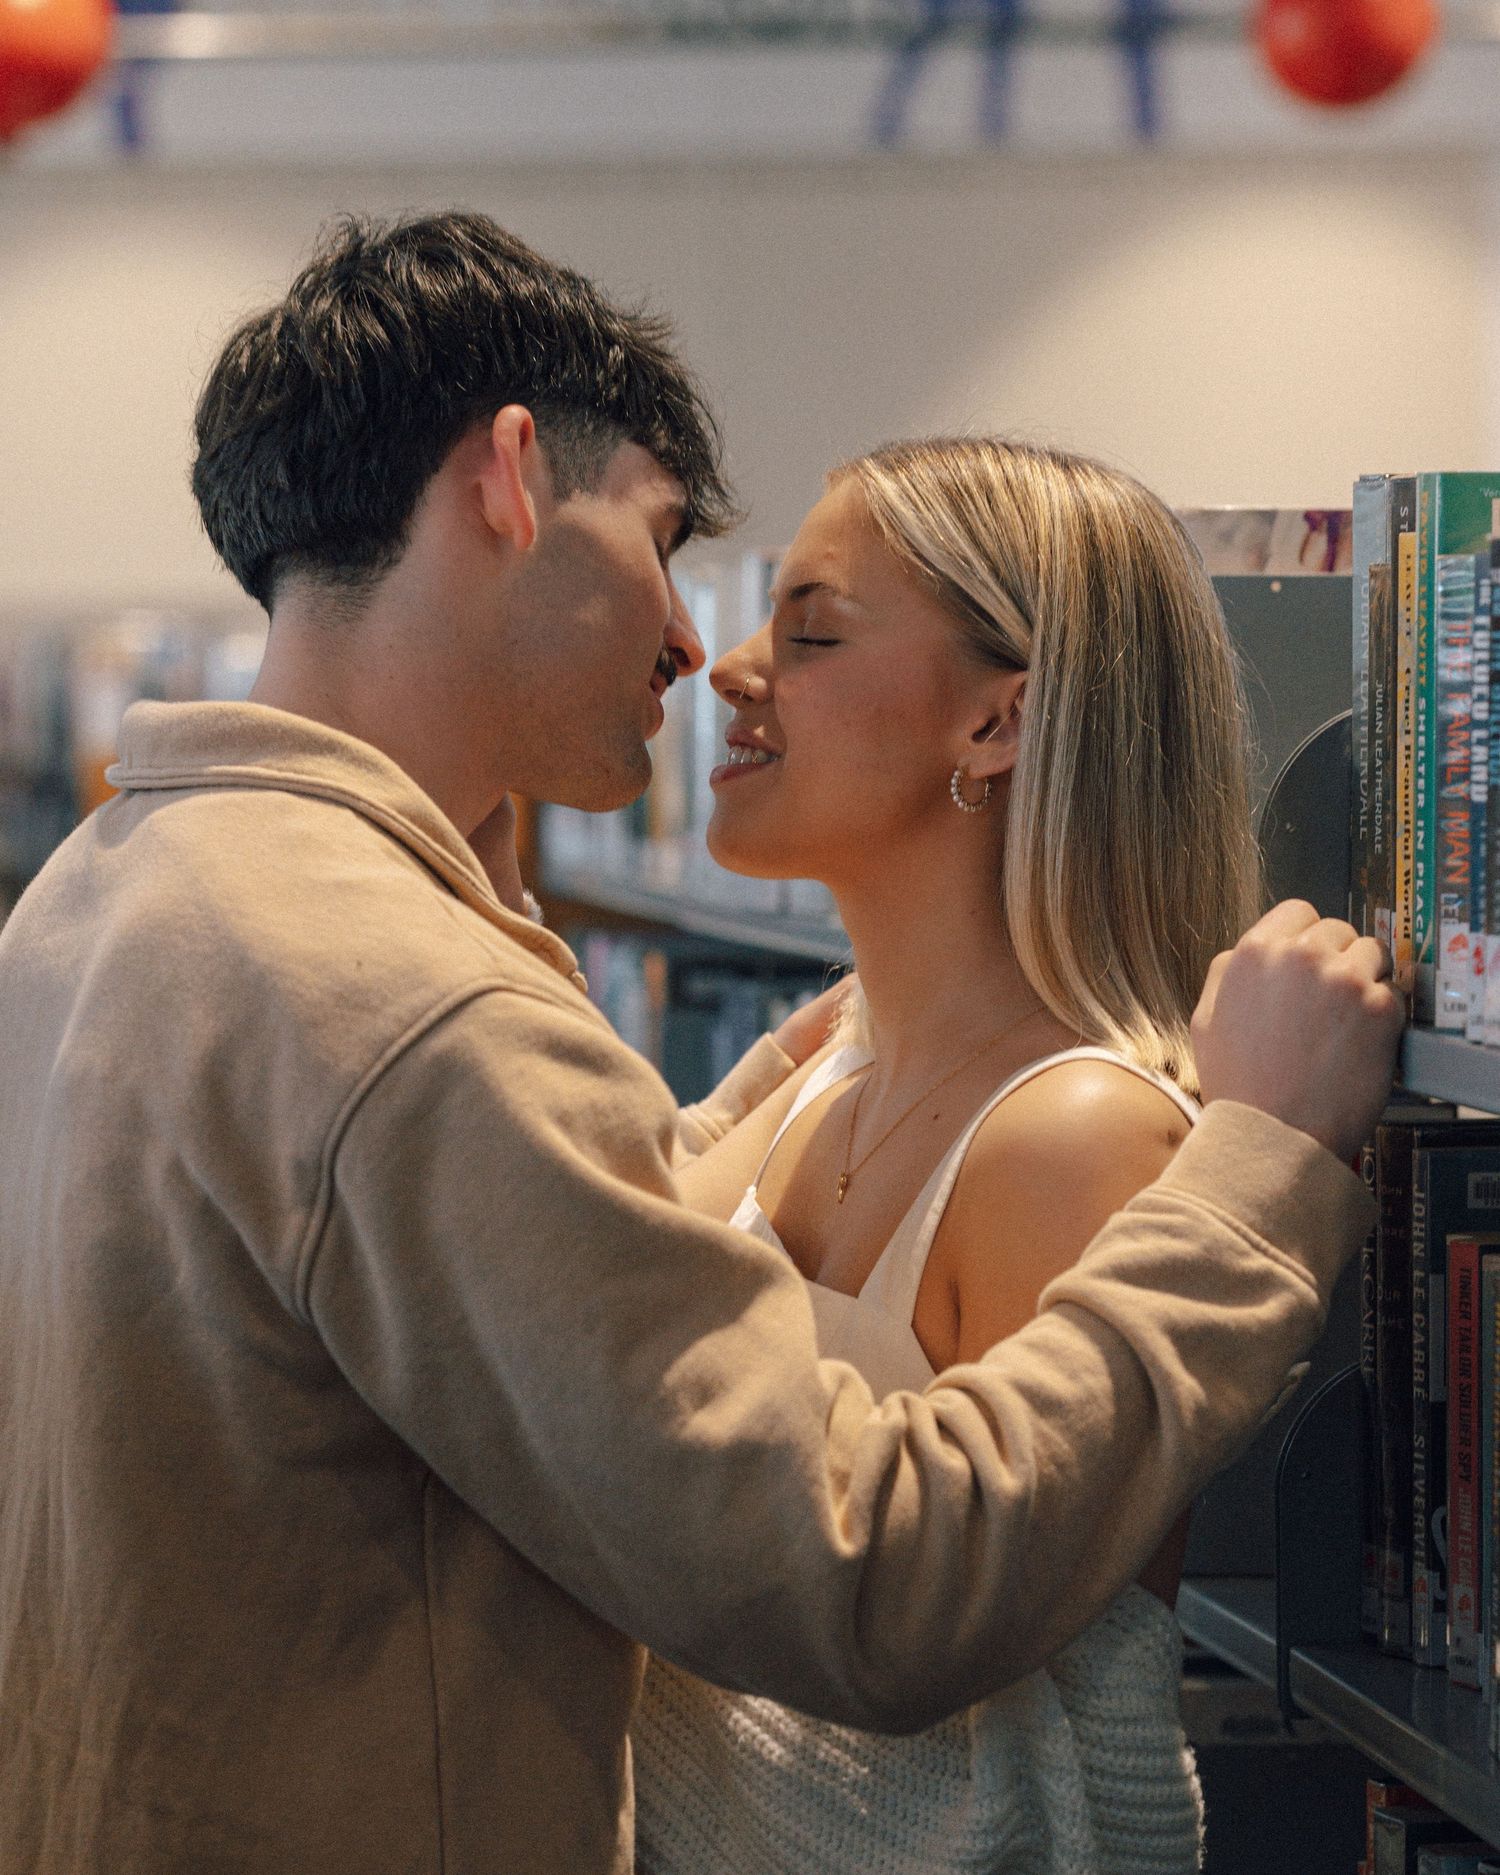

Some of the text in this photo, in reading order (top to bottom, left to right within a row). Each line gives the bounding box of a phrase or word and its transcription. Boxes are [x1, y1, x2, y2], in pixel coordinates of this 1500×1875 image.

[1418, 491, 1428, 688] DAVID LEAVITT
[1373, 679, 1384, 855] JULIAN LEATHERDALE
[1416, 697, 1427, 944] SHELTER IN PLACE
[1445, 619, 1472, 887] THE FAMILY MAN
[1412, 1183, 1426, 1258] JOHN
[1412, 1269, 1426, 1300] LE
[1457, 1266, 1473, 1485] TINKER TAILOR SOLDIER SPY
